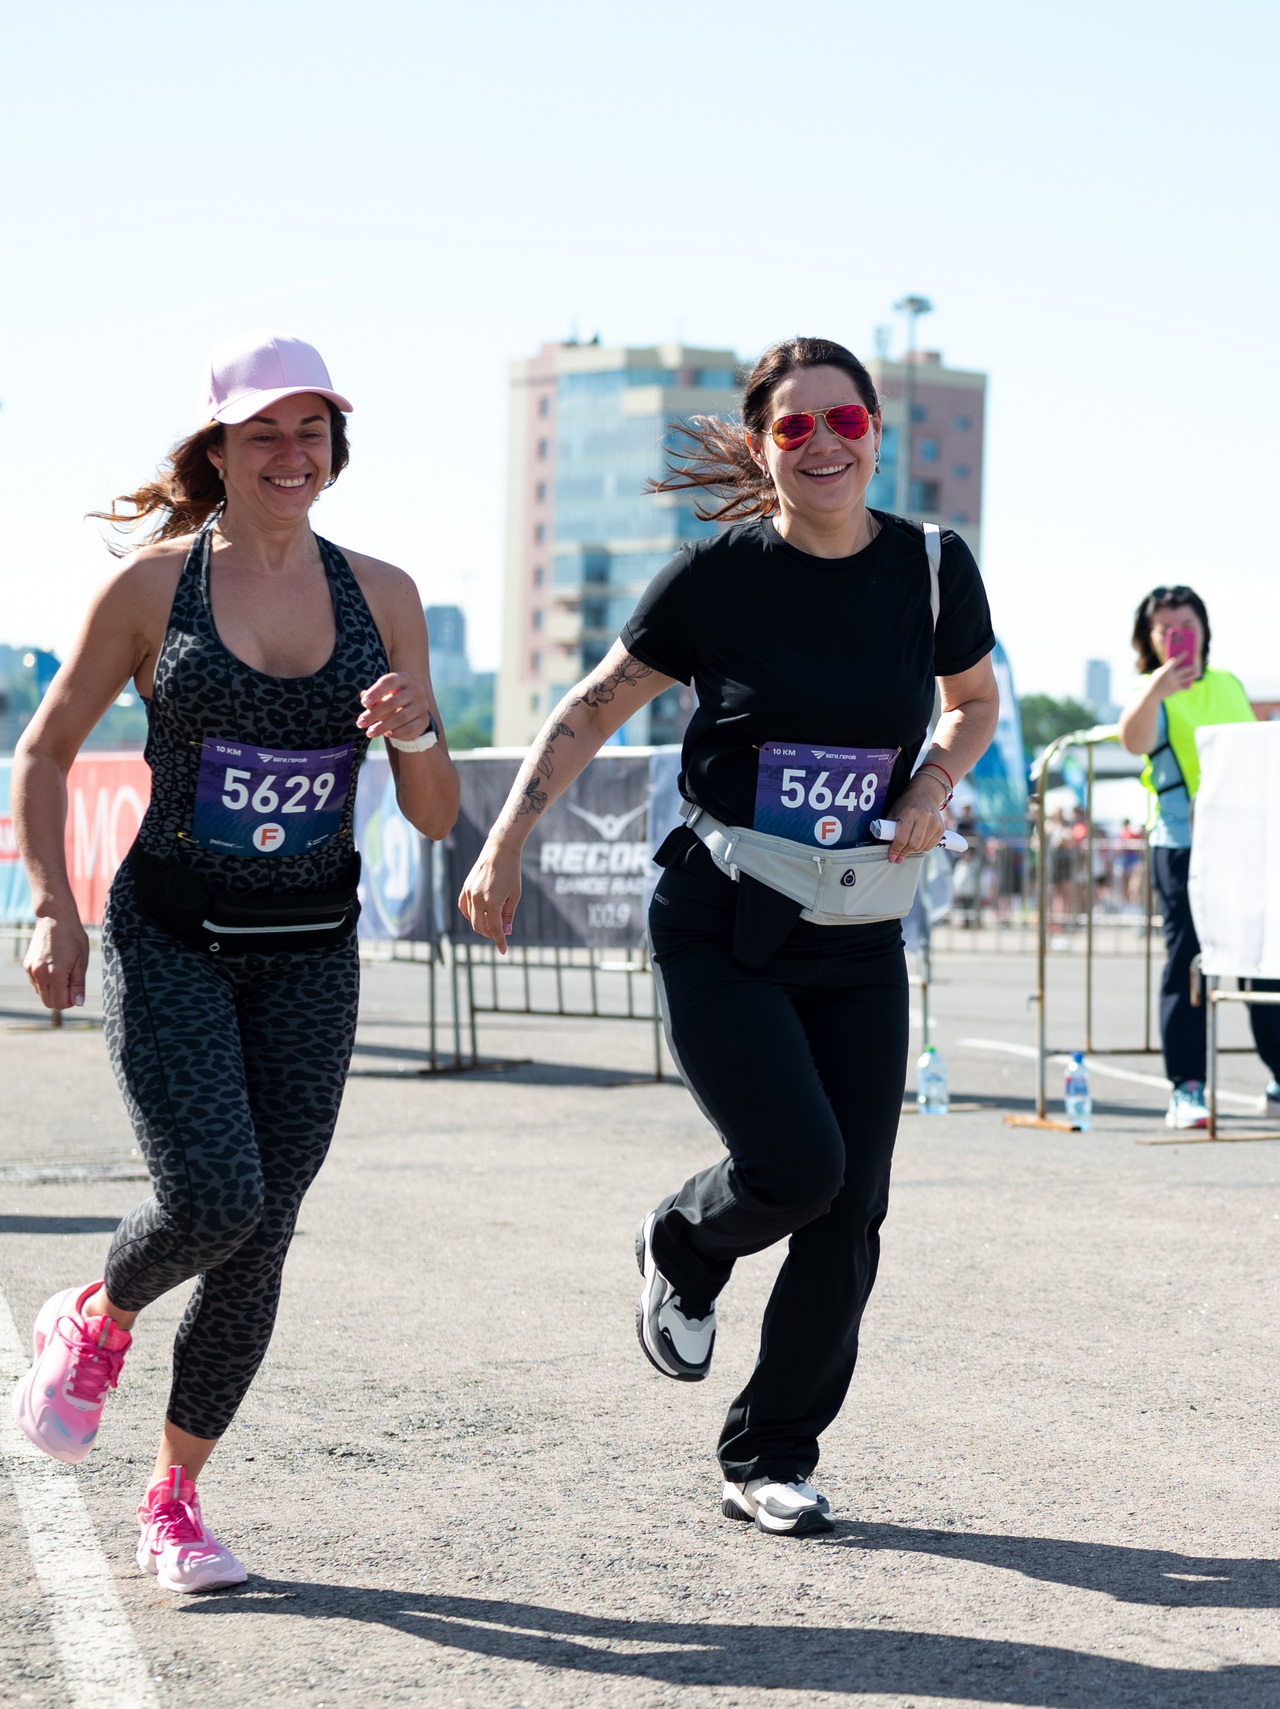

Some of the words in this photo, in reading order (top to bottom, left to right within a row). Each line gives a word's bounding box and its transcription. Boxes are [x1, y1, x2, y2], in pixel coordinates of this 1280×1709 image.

[216, 745, 225, 753] 10
[772, 748, 781, 756] 10
[221, 767, 336, 814] 5629
[780, 768, 878, 812] 5648
[260, 828, 280, 847] F
[821, 821, 837, 840] F
